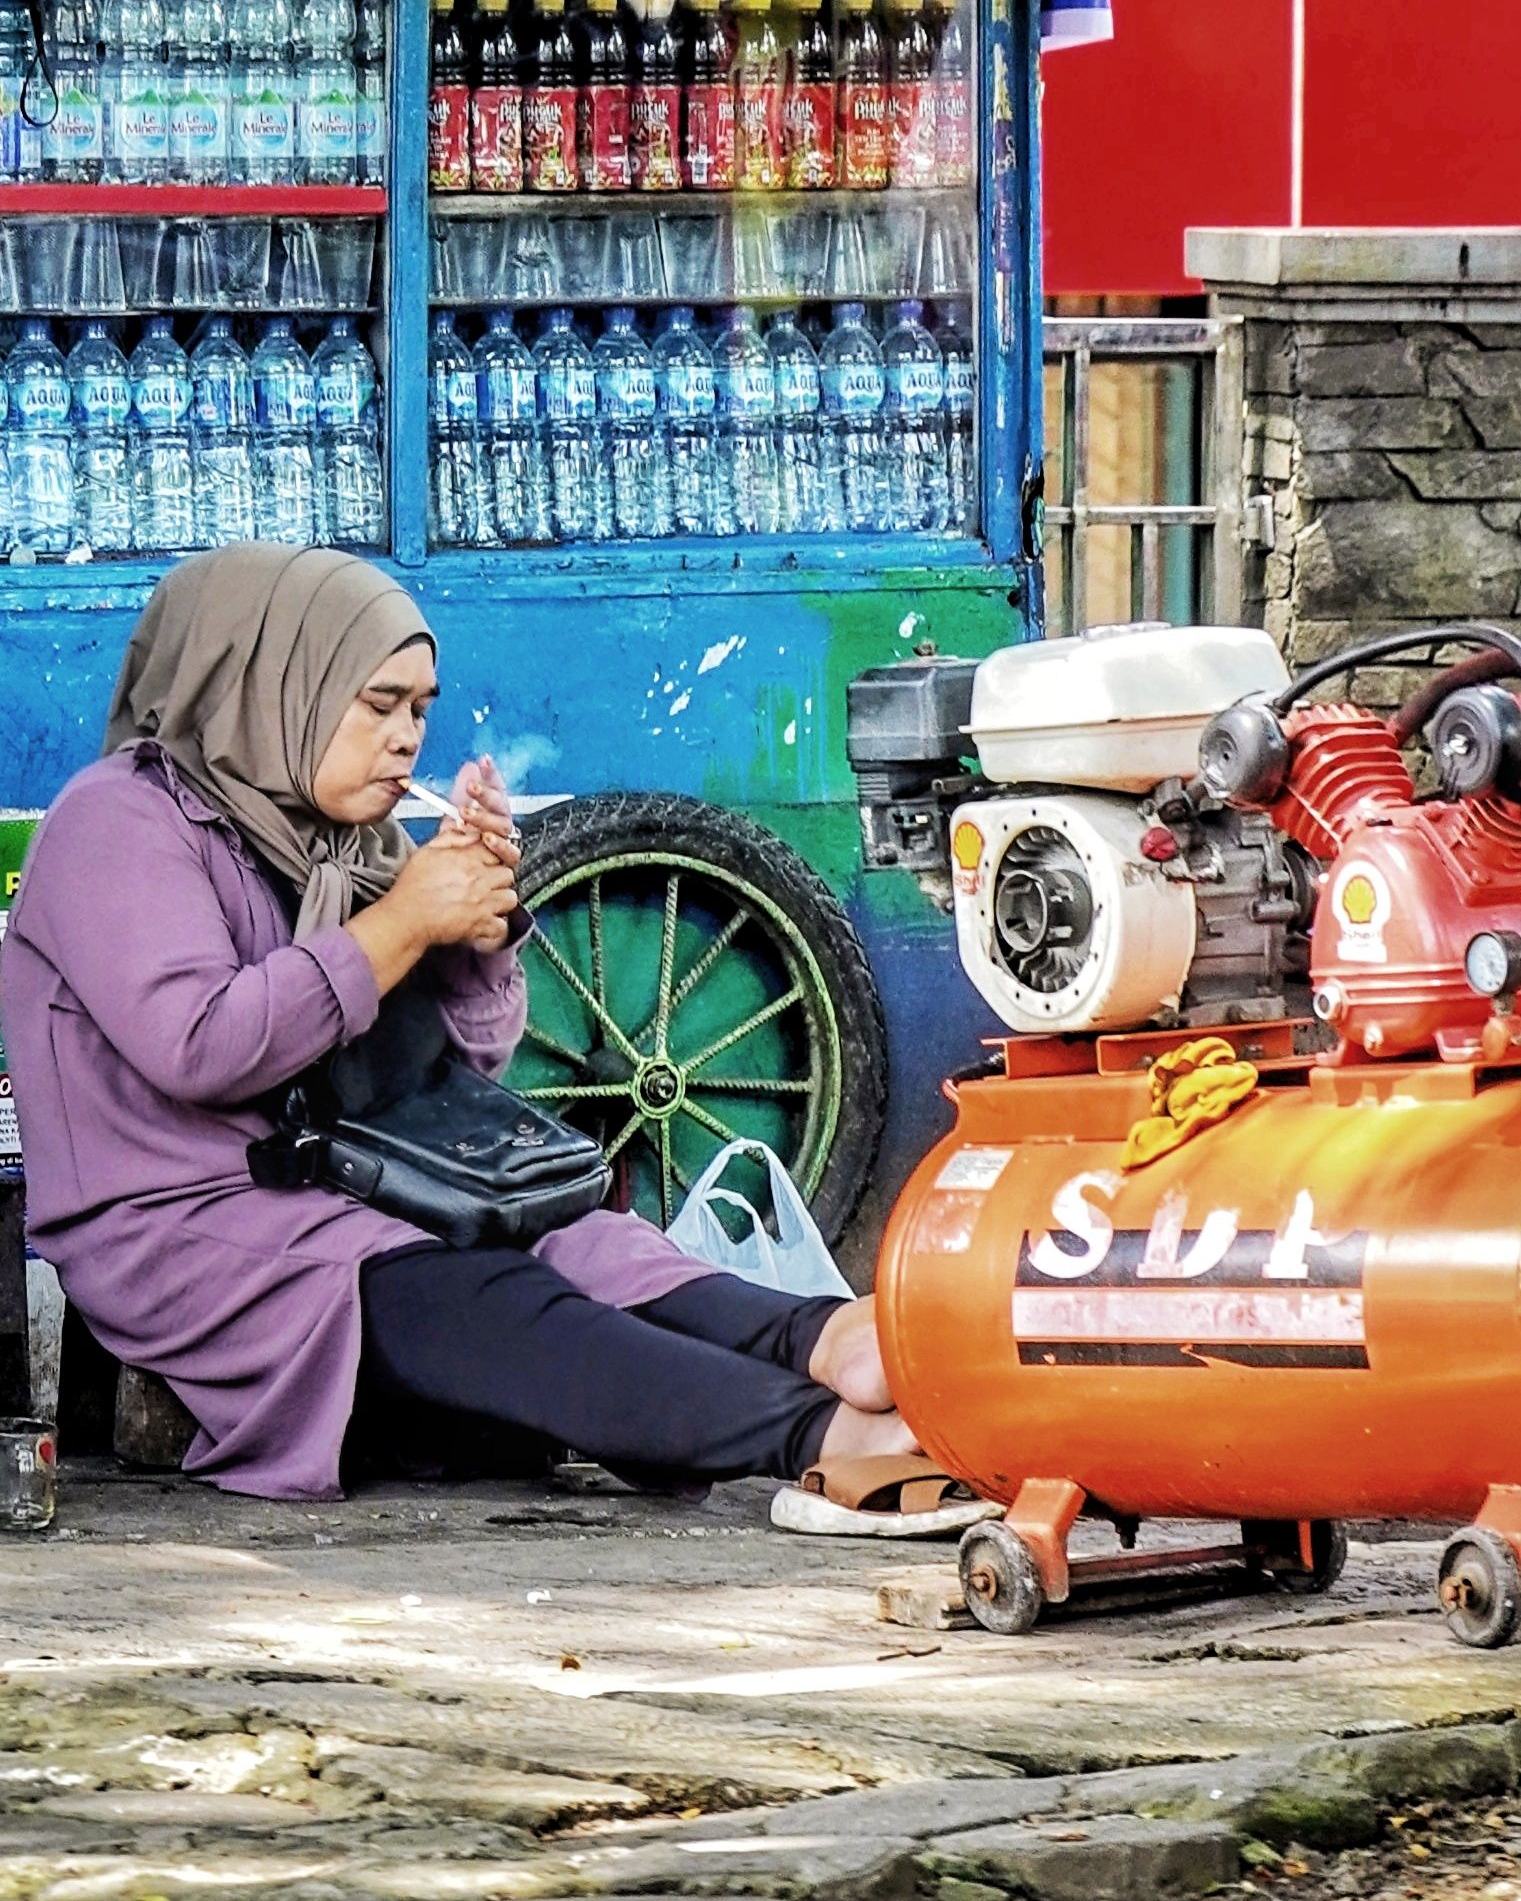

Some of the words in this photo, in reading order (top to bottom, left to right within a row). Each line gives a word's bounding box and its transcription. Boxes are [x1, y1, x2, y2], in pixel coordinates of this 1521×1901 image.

[67, 112, 81, 124] Le
[142, 112, 155, 123] Le
[185, 112, 199, 123] Le
[260, 112, 273, 123] Le
[328, 112, 341, 123] Le
[294, 384, 316, 401] AQU
[686, 375, 712, 394] AQU
[745, 375, 773, 394] AQU
[26, 388, 65, 407] AQUA
[89, 387, 127, 405] AQUA
[140, 387, 182, 406] AQUA
